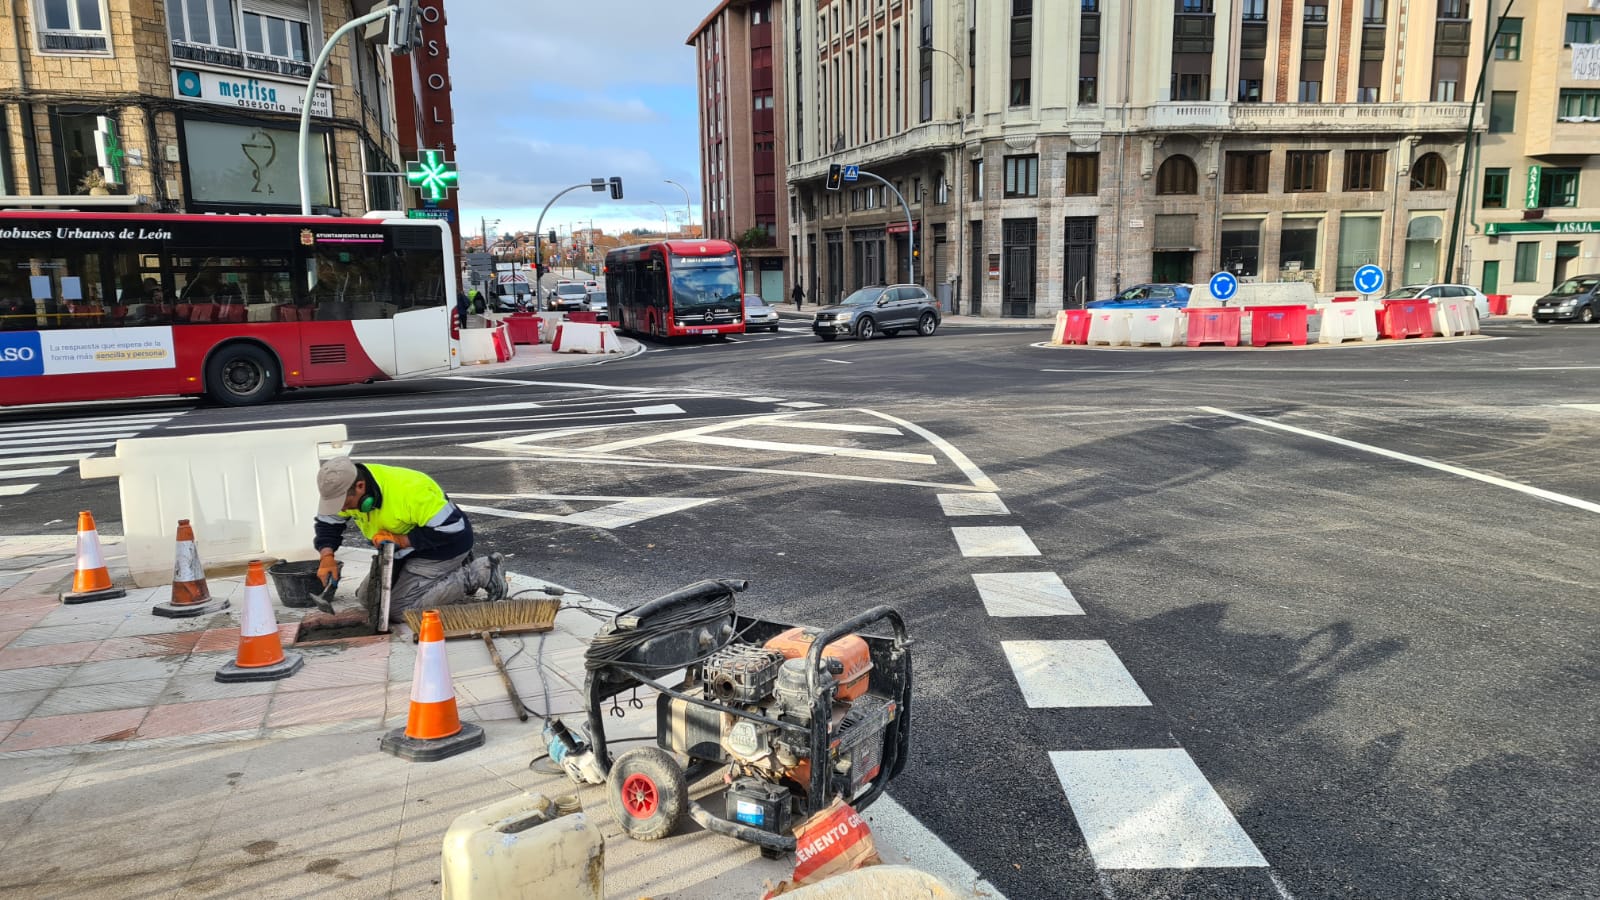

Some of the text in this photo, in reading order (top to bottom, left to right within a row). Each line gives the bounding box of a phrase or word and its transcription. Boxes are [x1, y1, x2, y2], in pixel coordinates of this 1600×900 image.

[218, 79, 277, 103] merfisa
[237, 98, 286, 112] asesoria
[298, 95, 328, 108] laoral
[291, 106, 329, 117] meantil
[1527, 166, 1538, 208] ASAJA
[56, 227, 116, 239] Urbanos
[119, 228, 134, 239] de
[138, 228, 172, 240] León
[1562, 222, 1593, 233] ASAJA
[61, 344, 99, 352] respuesta
[101, 343, 115, 351] que
[116, 342, 142, 350] espera
[51, 353, 75, 361] forma
[76, 352, 93, 360] más
[95, 351, 125, 359] sencilla
[132, 350, 165, 359] personal
